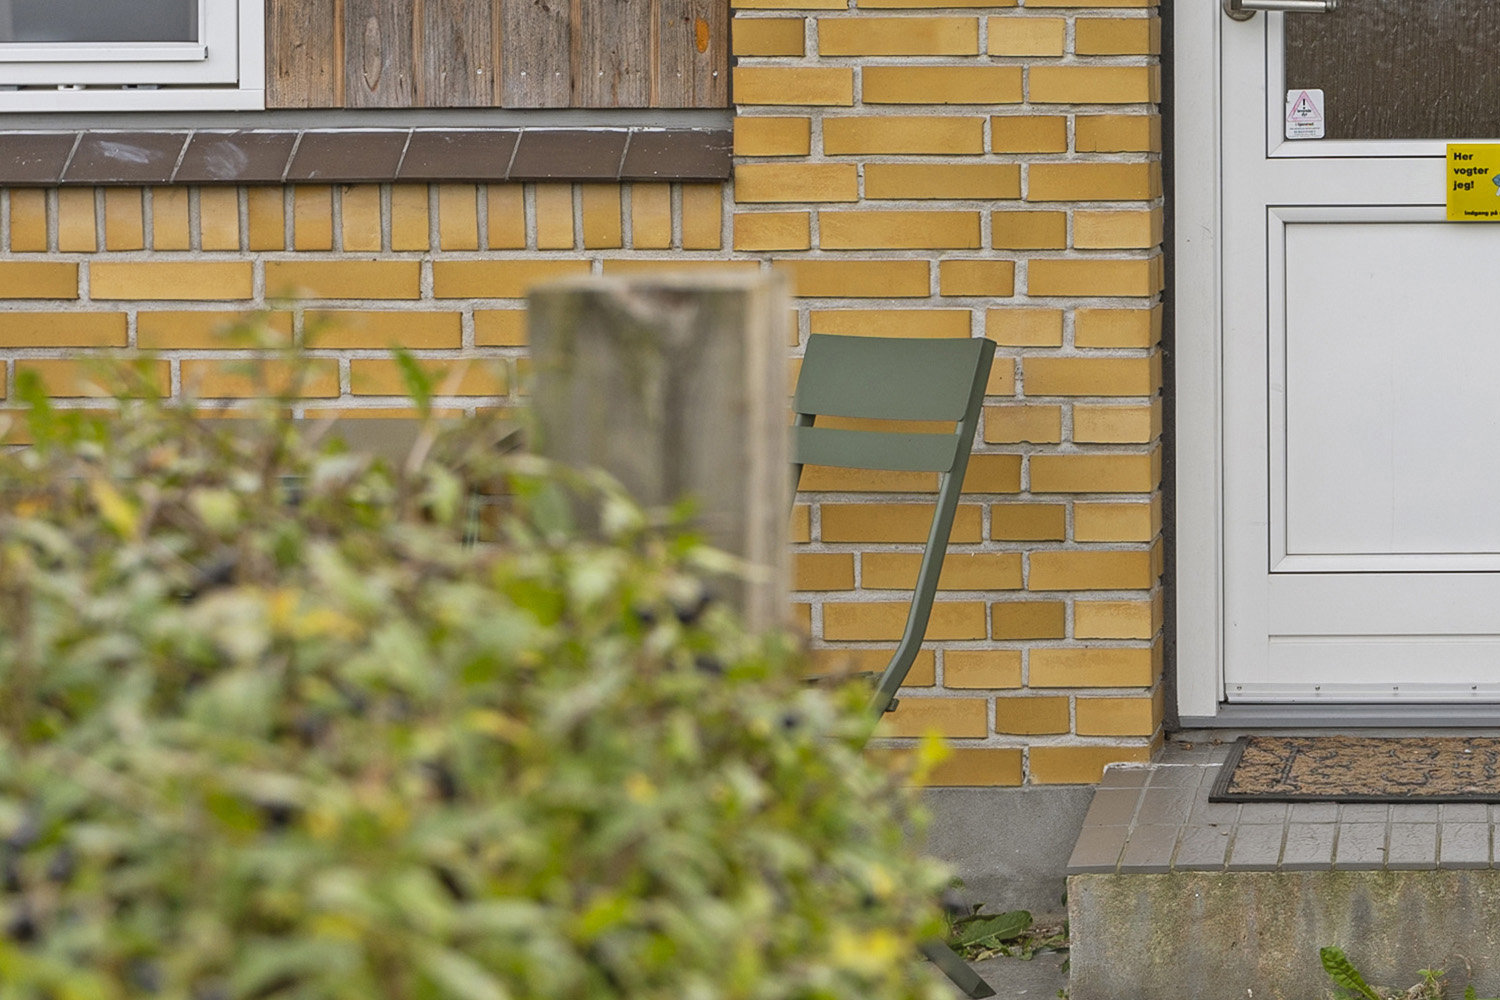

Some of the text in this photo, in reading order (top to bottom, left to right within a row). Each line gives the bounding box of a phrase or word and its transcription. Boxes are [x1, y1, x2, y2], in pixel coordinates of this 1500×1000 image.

[1453, 152, 1473, 160] Her
[1453, 167, 1489, 176] vogter
[1453, 181, 1474, 191] jeg!
